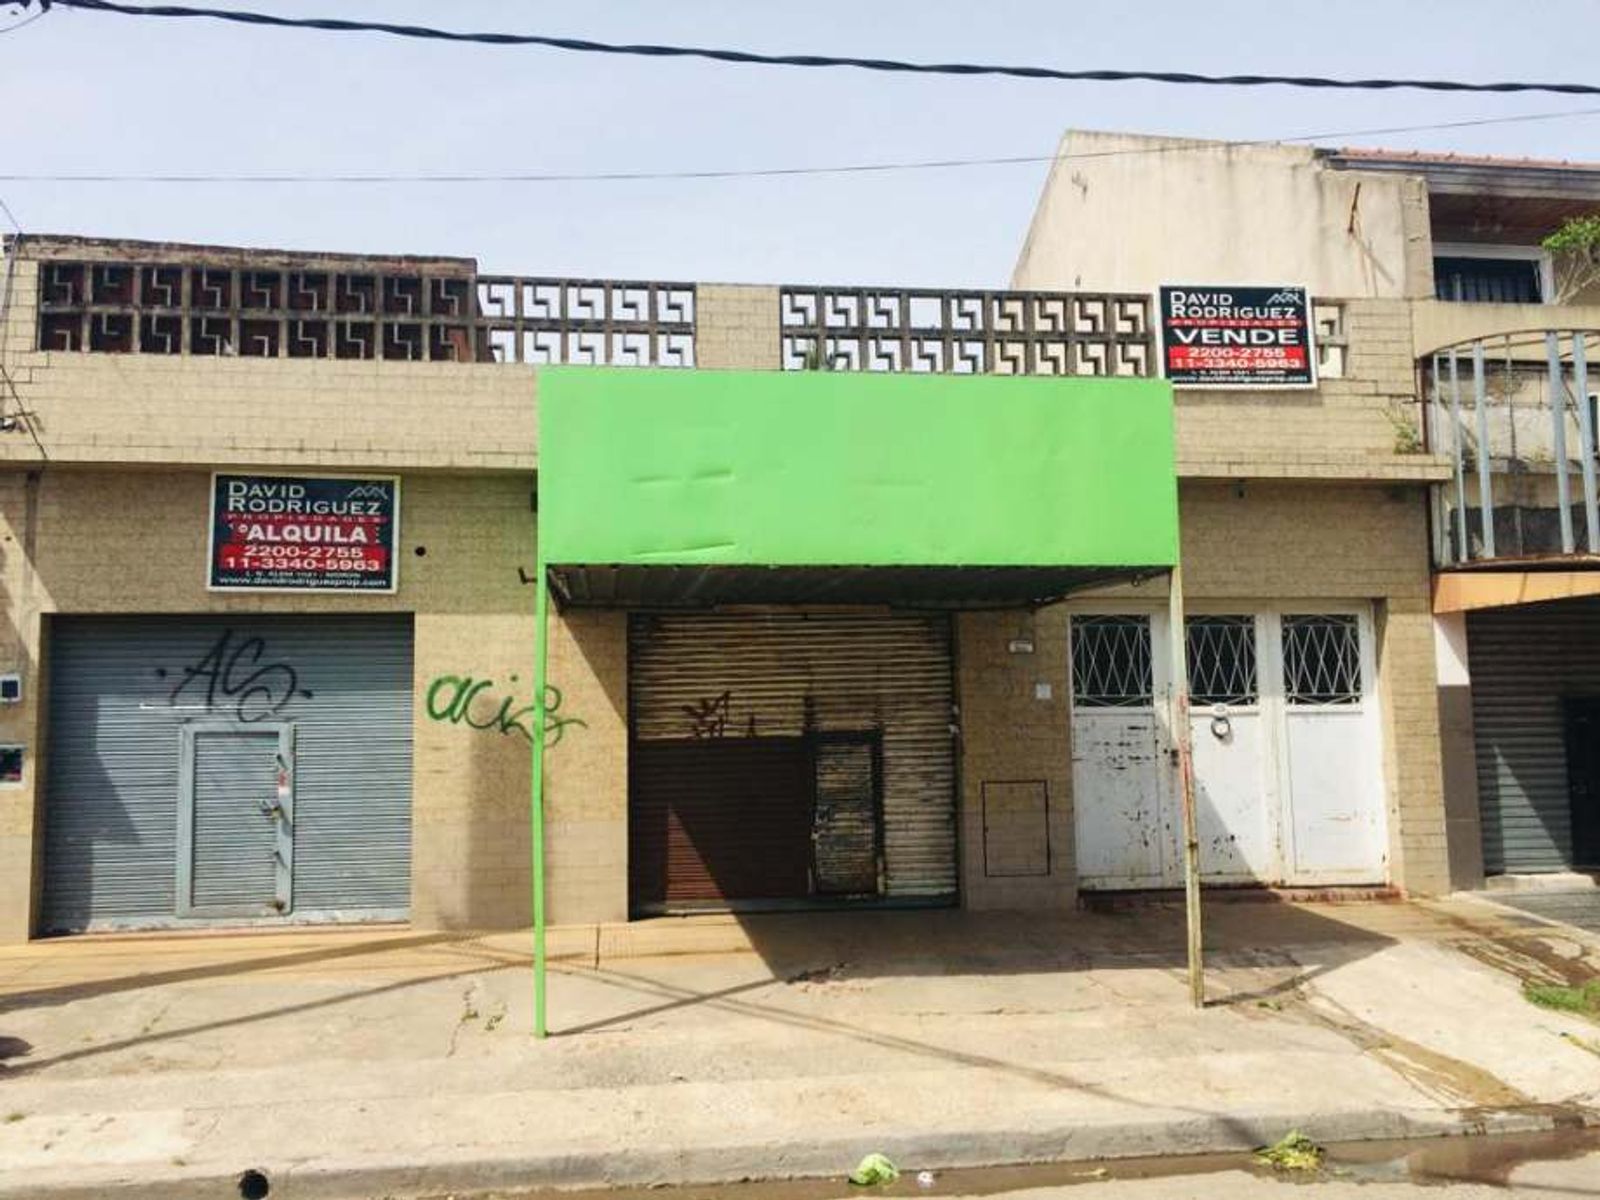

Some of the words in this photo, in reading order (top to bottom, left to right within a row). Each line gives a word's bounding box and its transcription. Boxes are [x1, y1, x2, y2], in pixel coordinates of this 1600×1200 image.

[1170, 291, 1233, 306] DAVID
[1170, 304, 1297, 319] RODRIGUEZ
[1173, 328, 1299, 344] VENDE
[1188, 346, 1287, 358] 2200-2755
[1174, 357, 1301, 369] 11-3340-5963
[228, 481, 306, 498] DAVID
[228, 497, 382, 515] RODRIGUEZ
[246, 524, 369, 543] ALQUILA
[243, 544, 364, 558] 2200-2755
[224, 557, 381, 572] 11-3340-5963
